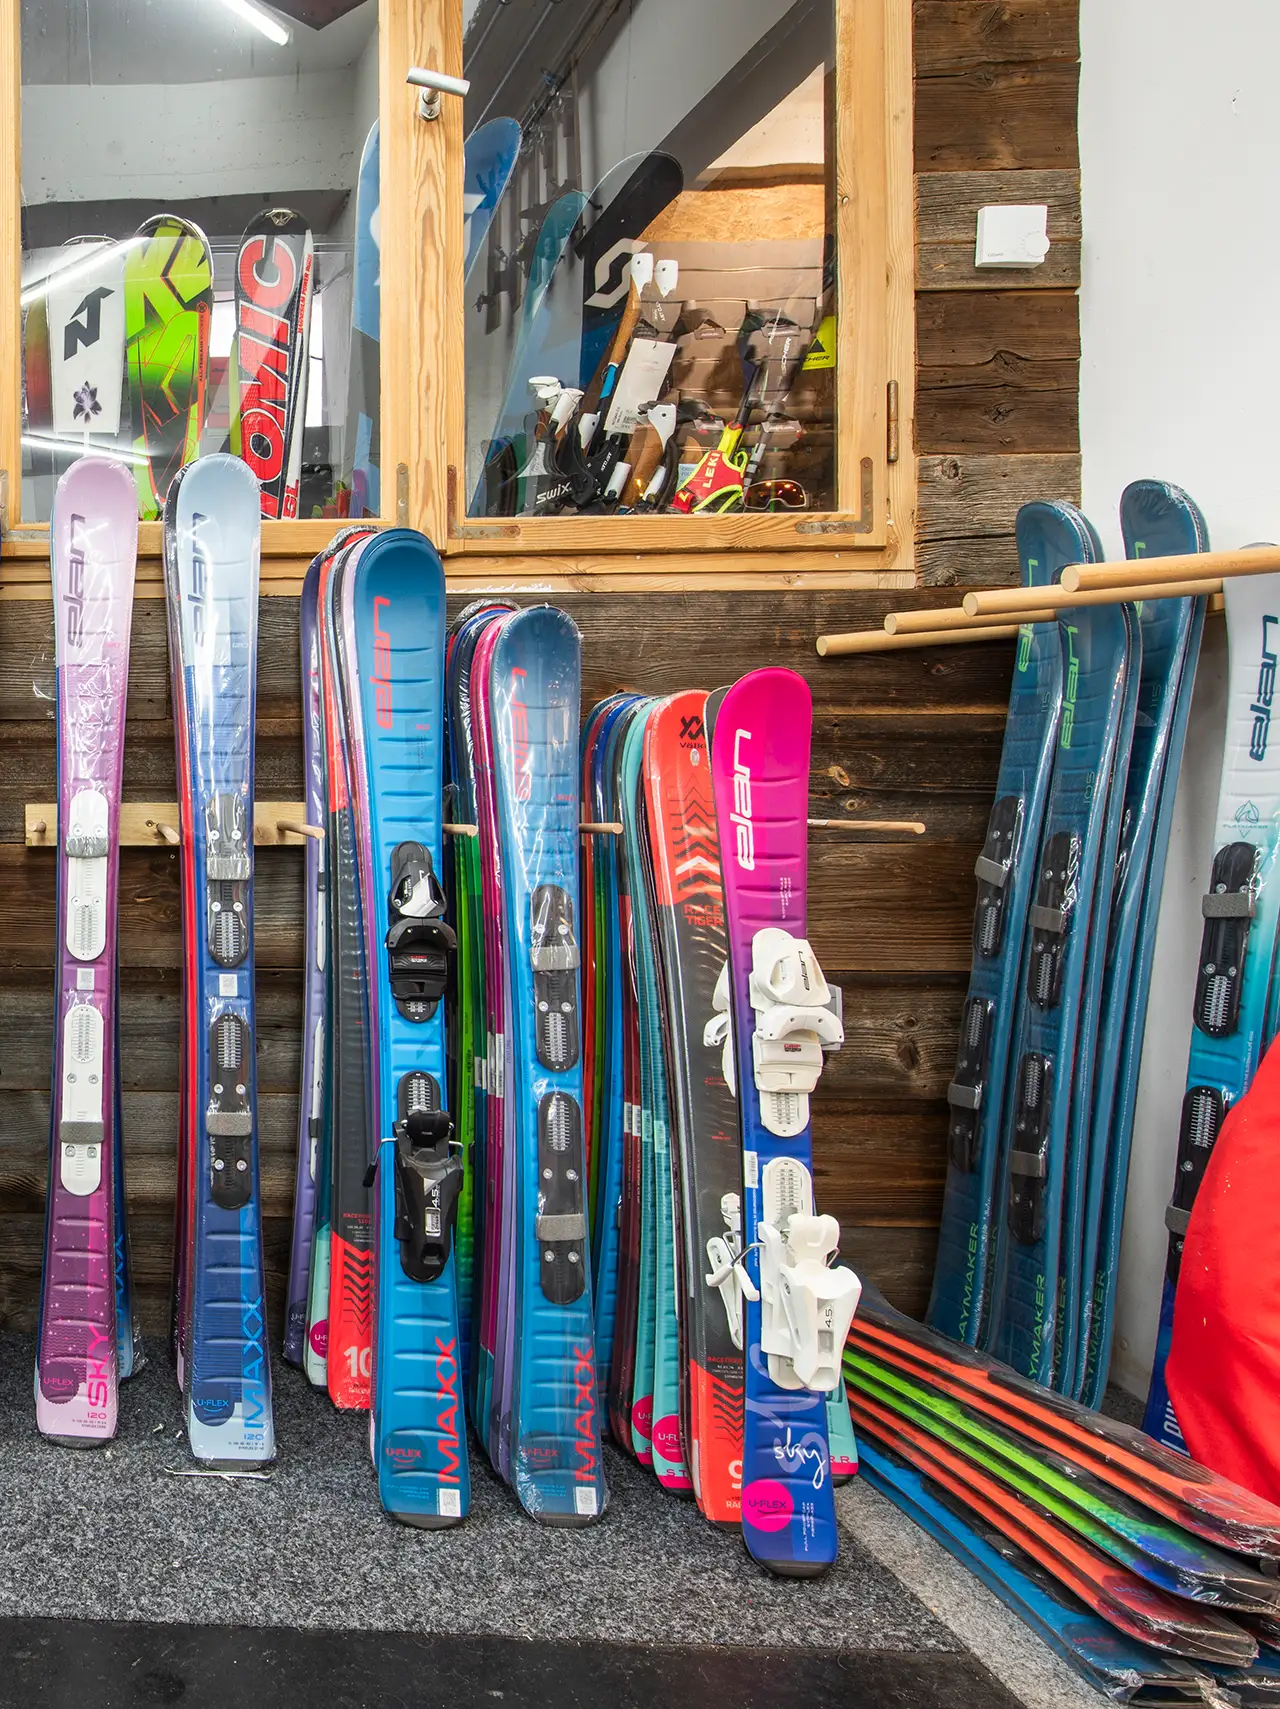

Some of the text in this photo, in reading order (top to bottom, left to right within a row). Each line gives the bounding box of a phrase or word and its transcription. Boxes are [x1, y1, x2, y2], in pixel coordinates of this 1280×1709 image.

[237, 234, 297, 520] OMIC
[702, 452, 721, 489] LEKI
[63, 513, 86, 648] elan
[188, 512, 210, 648] elan
[370, 596, 393, 730] elan
[1060, 625, 1079, 750] elan
[1249, 615, 1280, 762] elan
[508, 667, 531, 801] elan
[729, 728, 756, 872] elan
[683, 903, 720, 914] RACE
[686, 915, 725, 927] TIGER
[798, 949, 811, 991] elan
[87, 1324, 109, 1409] SKY
[242, 1294, 265, 1429] MAXX
[824, 1308, 835, 1329] 4.5
[87, 1411, 107, 1420] 120
[243, 1432, 265, 1441] 120
[435, 1336, 460, 1484] MAXX
[574, 1346, 597, 1482] MAXX
[773, 1427, 827, 1490] sky
